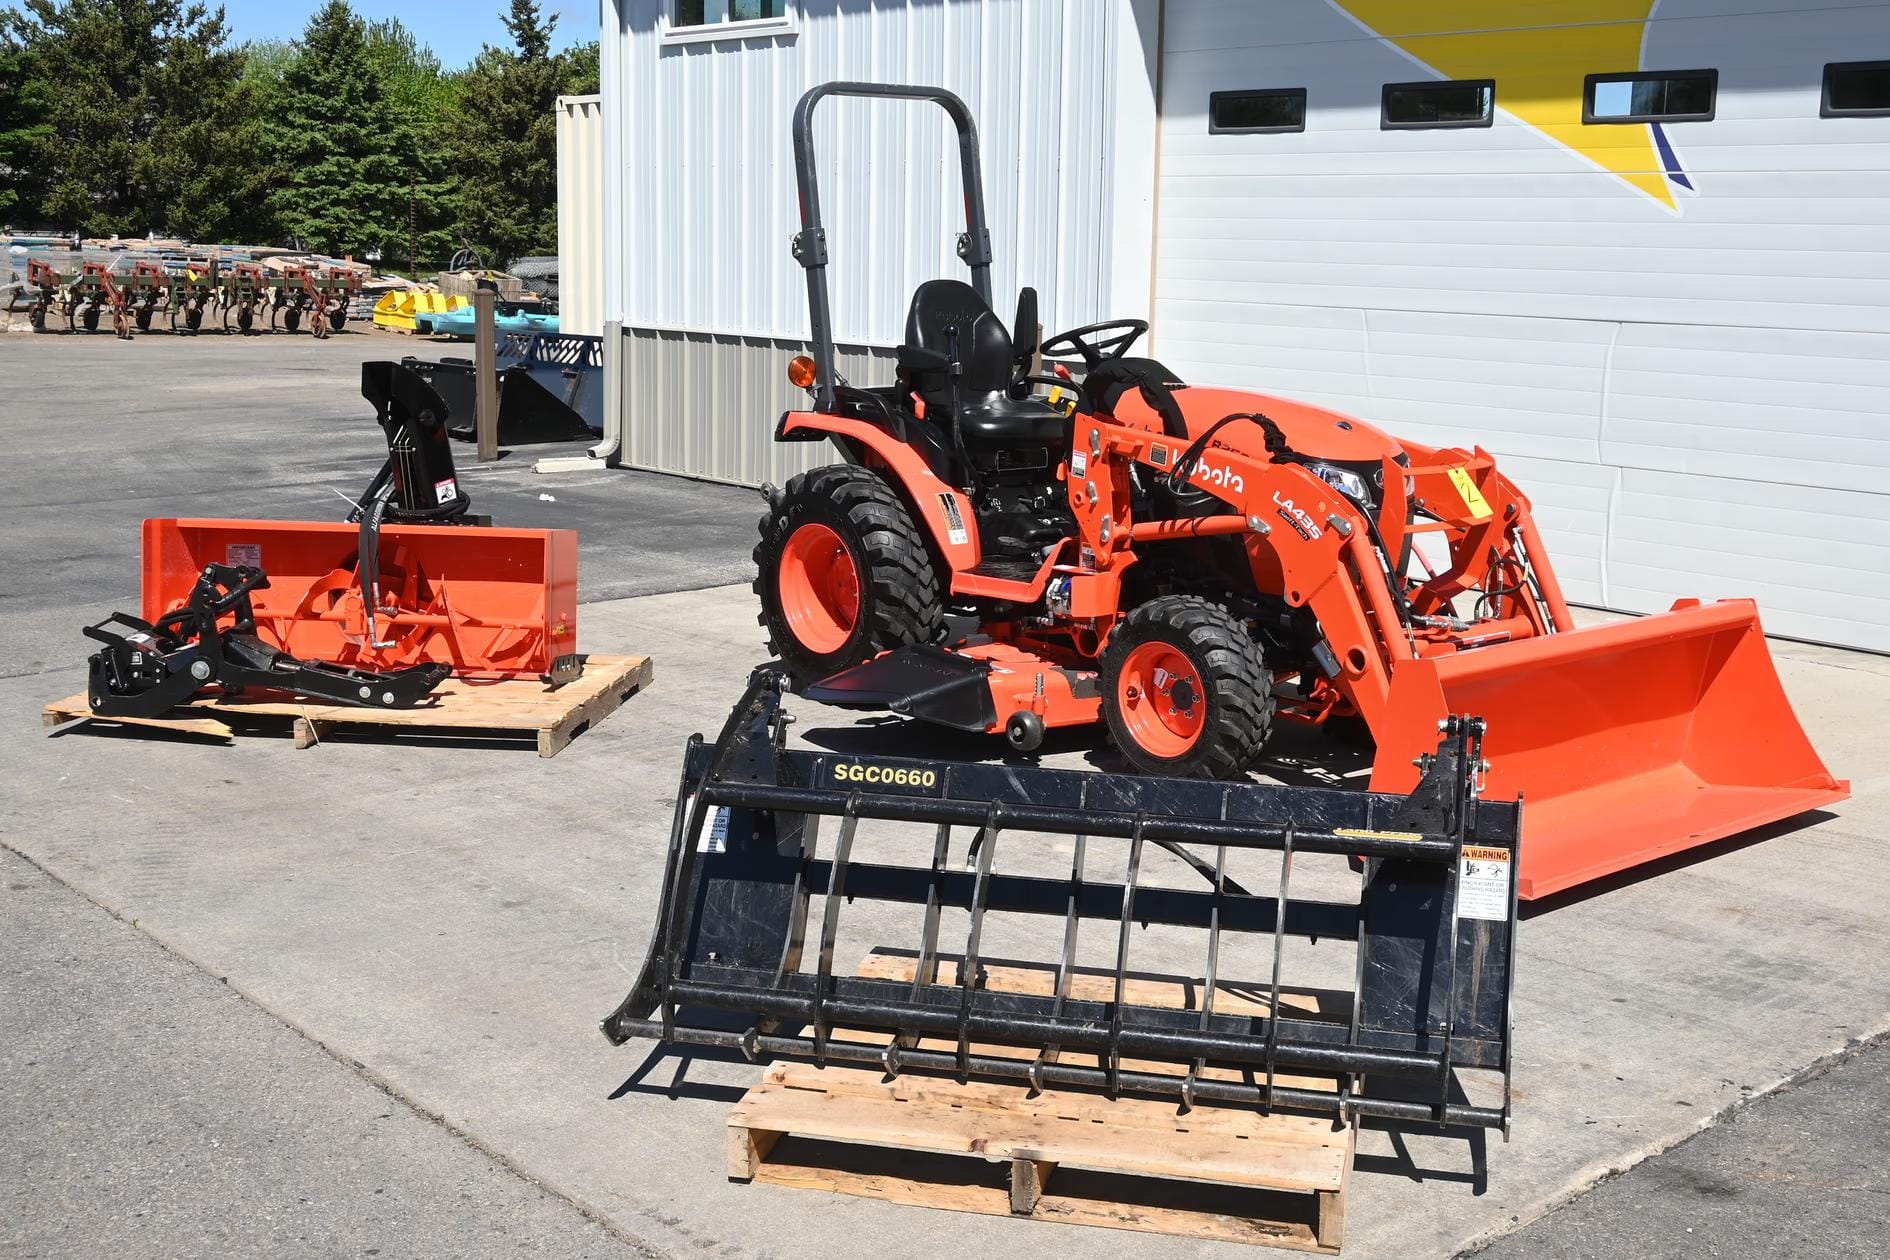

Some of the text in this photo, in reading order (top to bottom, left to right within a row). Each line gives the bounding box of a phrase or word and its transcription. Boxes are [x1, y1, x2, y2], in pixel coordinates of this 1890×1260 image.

[1460, 482, 1479, 503] 2
[1272, 490, 1323, 540] LA435
[834, 763, 936, 787] SGC0660
[1471, 849, 1507, 861] WARNING
